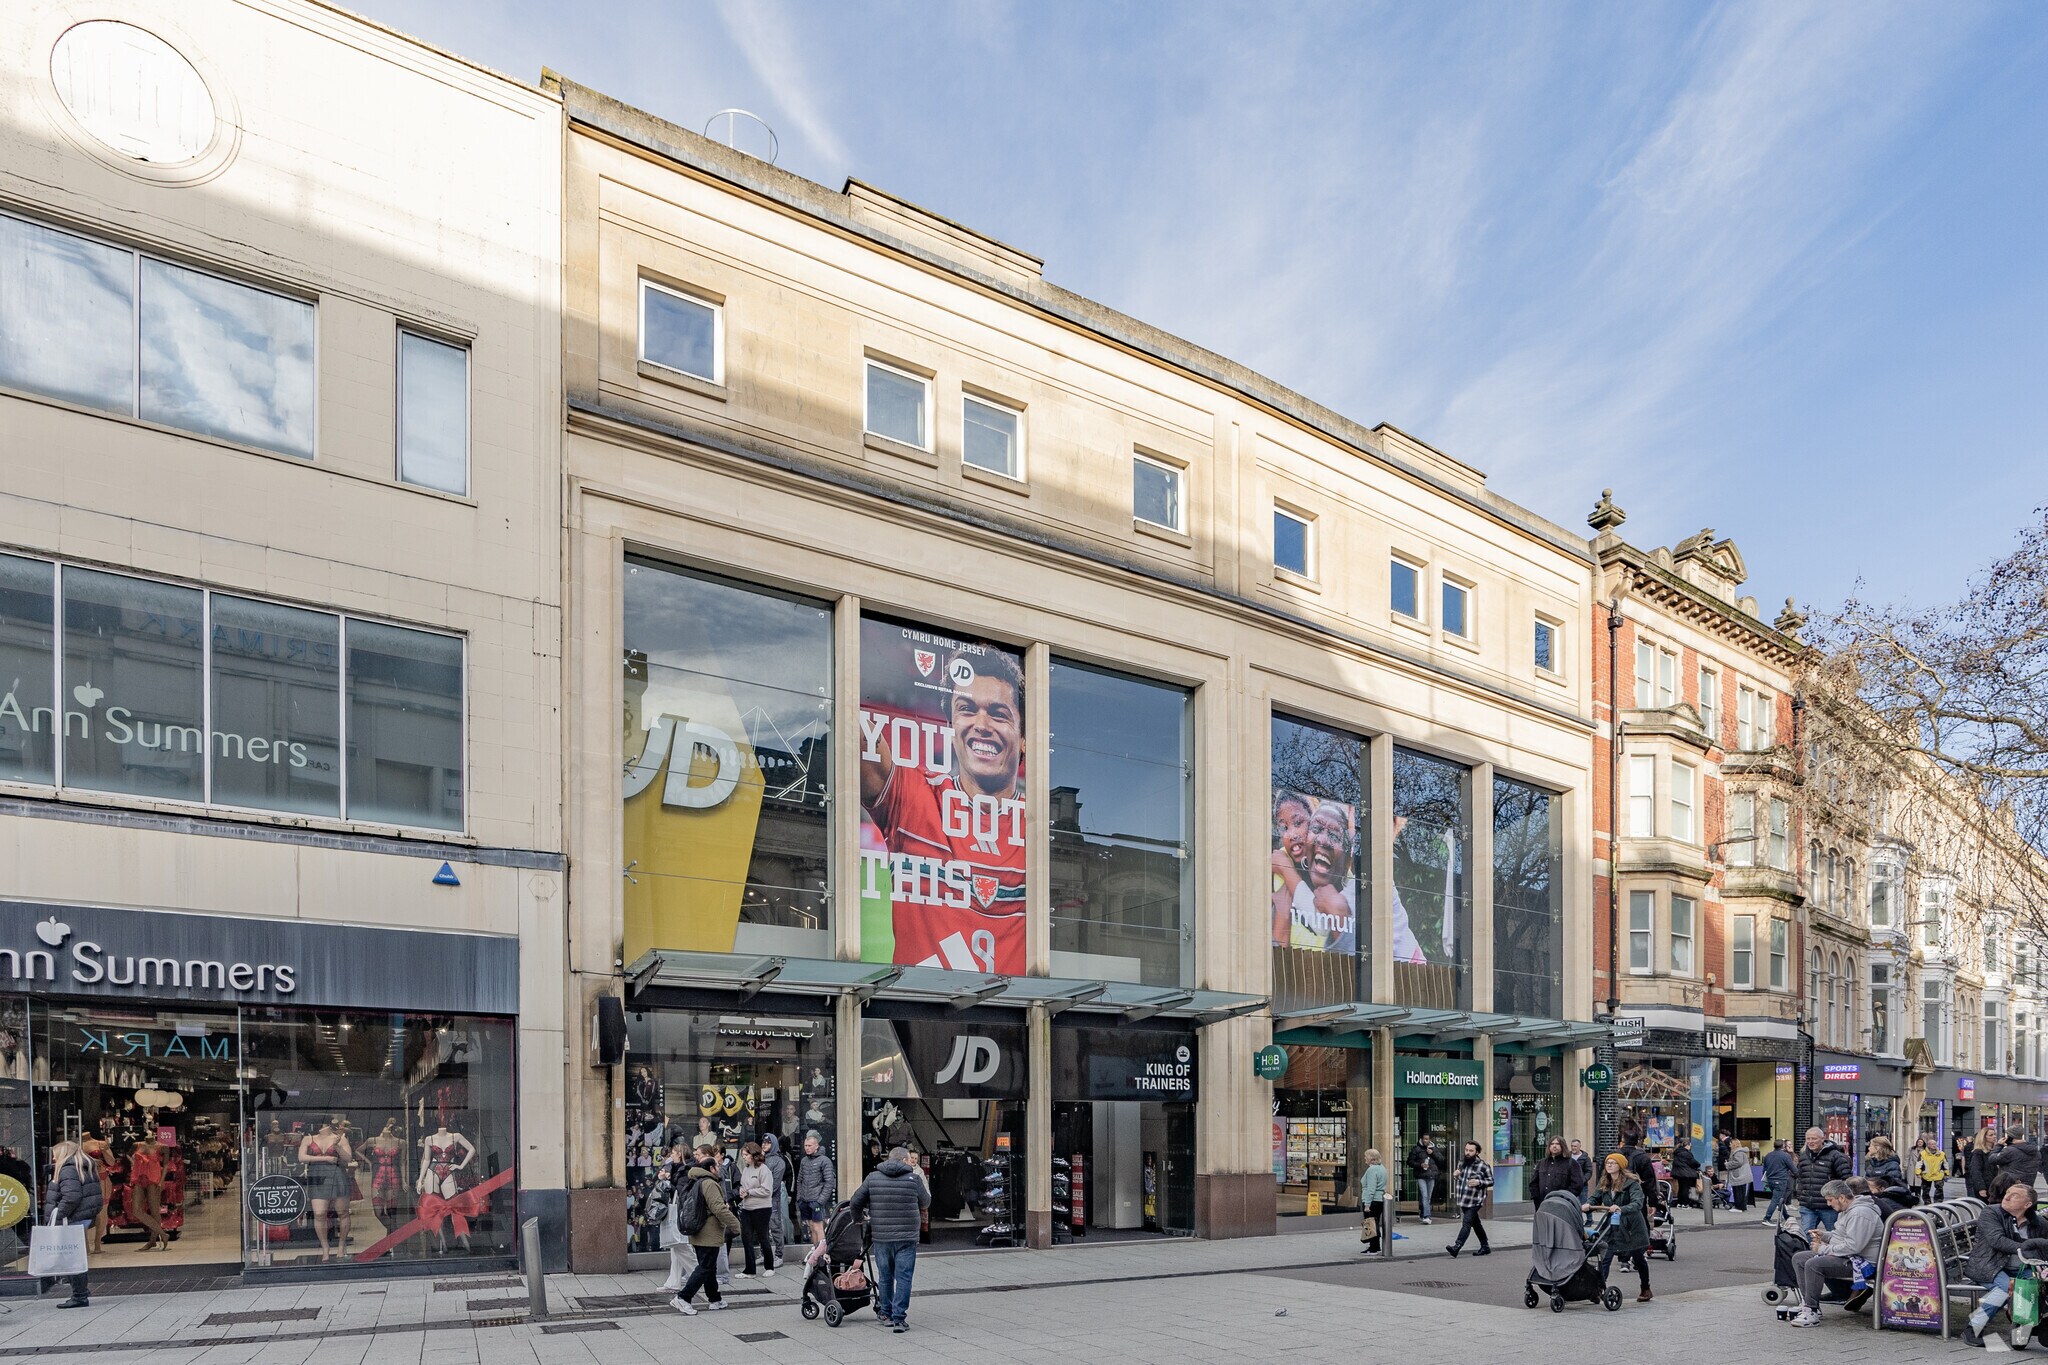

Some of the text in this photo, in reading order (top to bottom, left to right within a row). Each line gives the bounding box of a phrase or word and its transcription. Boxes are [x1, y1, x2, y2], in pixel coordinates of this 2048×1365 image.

[902, 628, 987, 657] CYMRU HOME JERSEY
[953, 665, 971, 680] JD
[0, 693, 308, 768] Ann Summers
[859, 710, 955, 774] YOU
[623, 713, 741, 809] JD
[942, 788, 1026, 847] GOT
[859, 849, 971, 909] THIS
[72, 941, 297, 993] Summers
[1706, 1032, 1736, 1050] LUSH
[935, 1035, 1000, 1085] JD
[1146, 1063, 1191, 1077] KING OF
[1134, 1076, 1191, 1091] TRAINERS
[1824, 1072, 1858, 1080] DIRECT
[1828, 1133, 1847, 1146] SALE
[258, 1207, 298, 1215] DISCOUNT
[39, 1243, 80, 1252] PRIMARK
